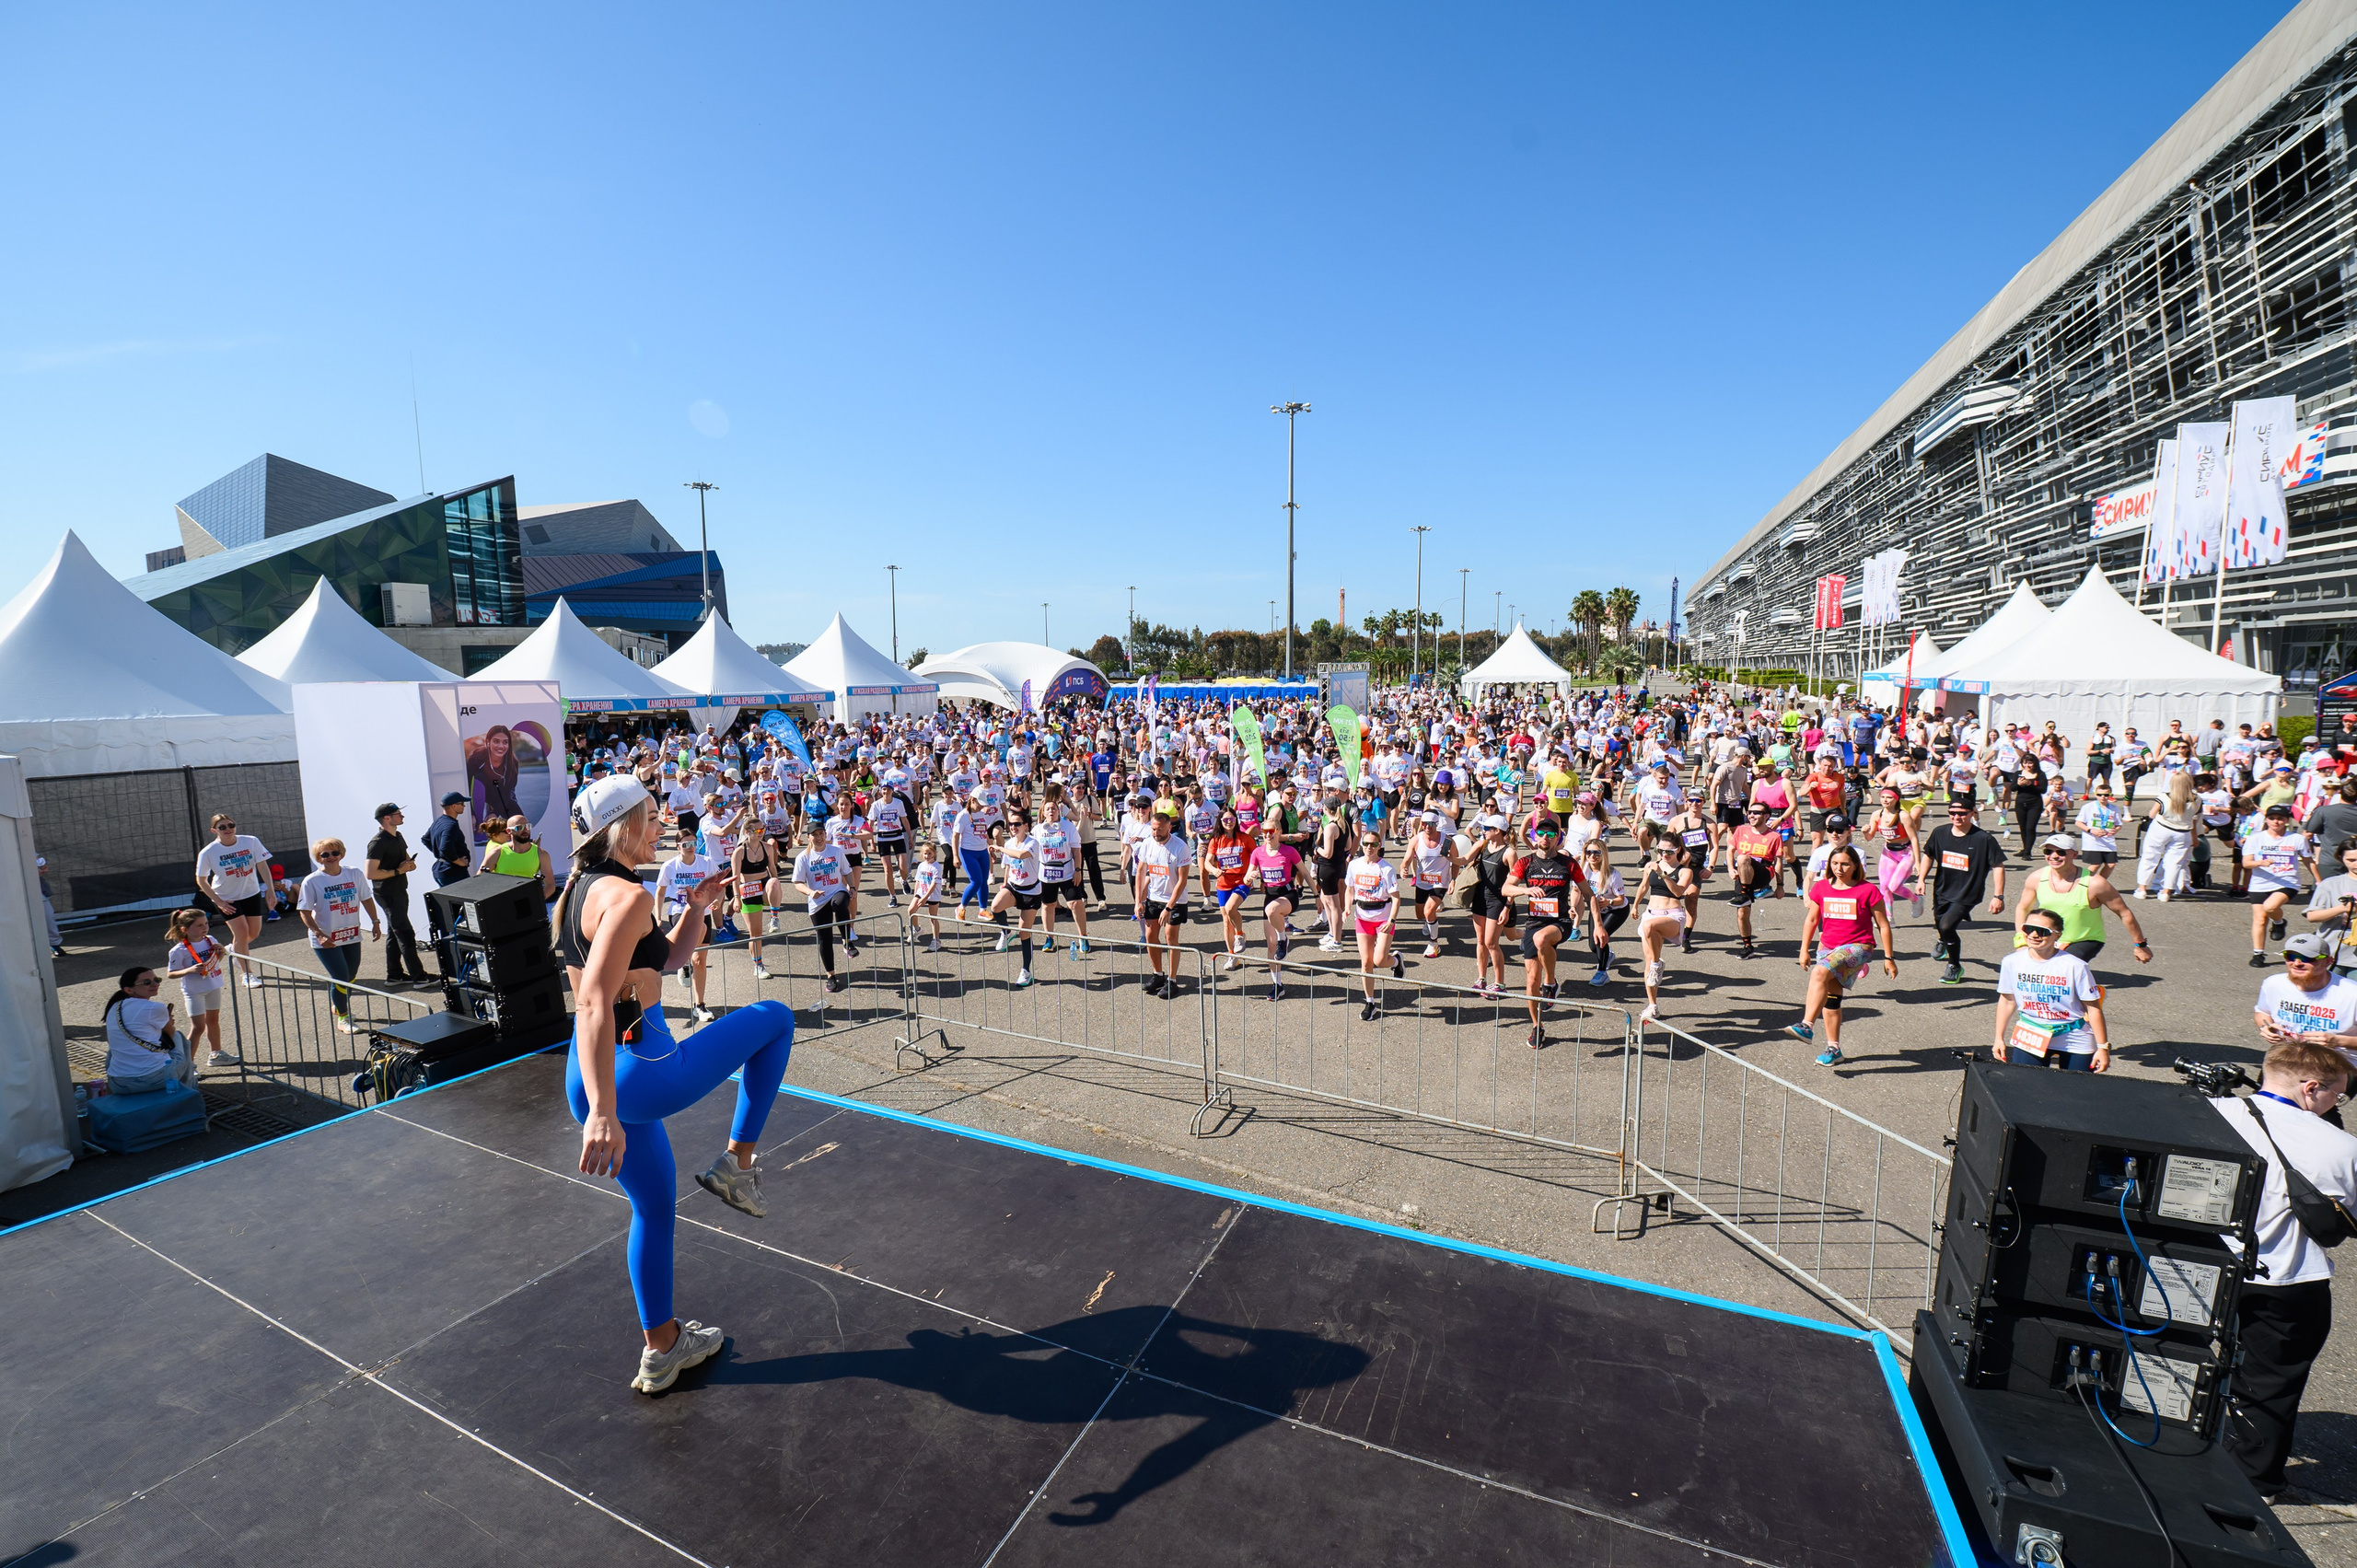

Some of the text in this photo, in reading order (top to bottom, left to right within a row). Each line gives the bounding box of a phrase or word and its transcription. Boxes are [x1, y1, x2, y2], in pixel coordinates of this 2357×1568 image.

[1073, 677, 1085, 686] ПСБ
[646, 697, 697, 709] КАМЕРА ХРАНЕНИЯ
[723, 695, 765, 705] КАМЕРА ХРАНЕНИЯ
[460, 705, 477, 716] де
[582, 701, 614, 711] ХРАНЕНИЯ
[1738, 842, 1769, 856] 中国
[1527, 878, 1565, 887] TRAINING
[1829, 903, 1851, 913] 40113
[334, 928, 355, 940] 20533
[2017, 973, 2067, 986] #ЗАБЕГ2025
[2030, 983, 2071, 995] ПЛАНЕТЫ
[2037, 993, 2061, 1003] БЕГУТ
[2038, 1010, 2071, 1020] С ТОБОЙ
[2280, 1000, 2336, 1019] #ЗАБЕГ2025
[2293, 1013, 2340, 1030] ПЛАНЕТЫ
